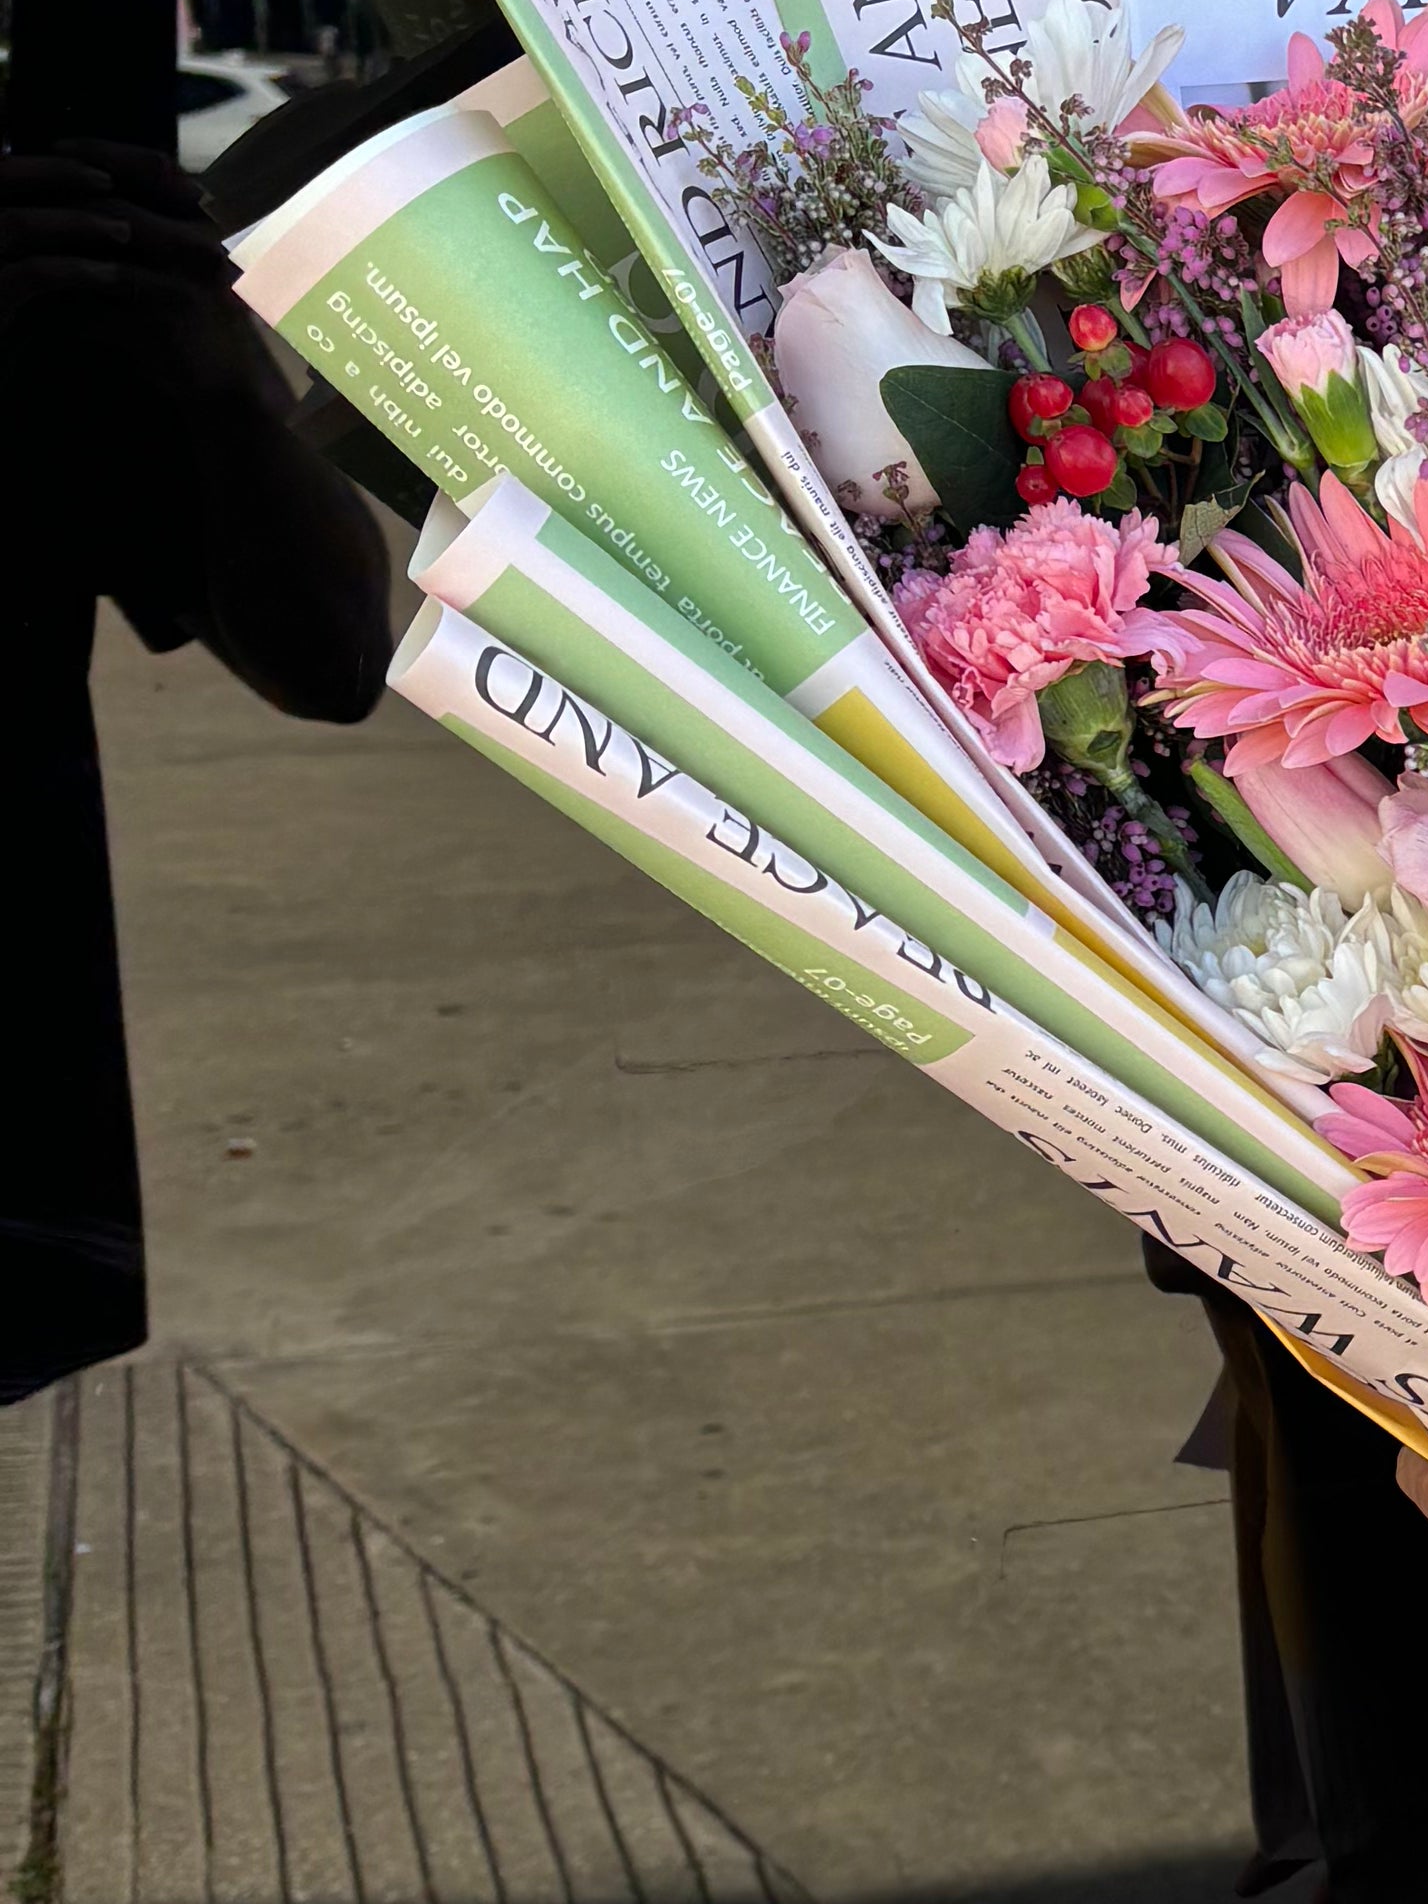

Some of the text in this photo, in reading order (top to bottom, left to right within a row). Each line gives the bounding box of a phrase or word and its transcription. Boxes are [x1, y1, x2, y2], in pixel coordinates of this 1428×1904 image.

[490, 180, 605, 304] HAP
[352, 254, 444, 351] ipsum.
[659, 258, 756, 393] Page-07
[322, 286, 446, 415] adipiscing
[342, 357, 362, 378] a
[429, 341, 476, 390] vel
[602, 306, 717, 433] AND
[365, 380, 424, 443] nibh
[464, 377, 589, 511] commodo
[424, 440, 470, 489] dui
[778, 449, 802, 475] dui
[796, 473, 832, 518] mauris
[581, 497, 674, 597] tempus
[656, 443, 836, 637] FINANCE NEWS
[802, 956, 935, 1051] Page-07
[1110, 1103, 1154, 1136] Donec
[1250, 1189, 1321, 1239] consectetur
